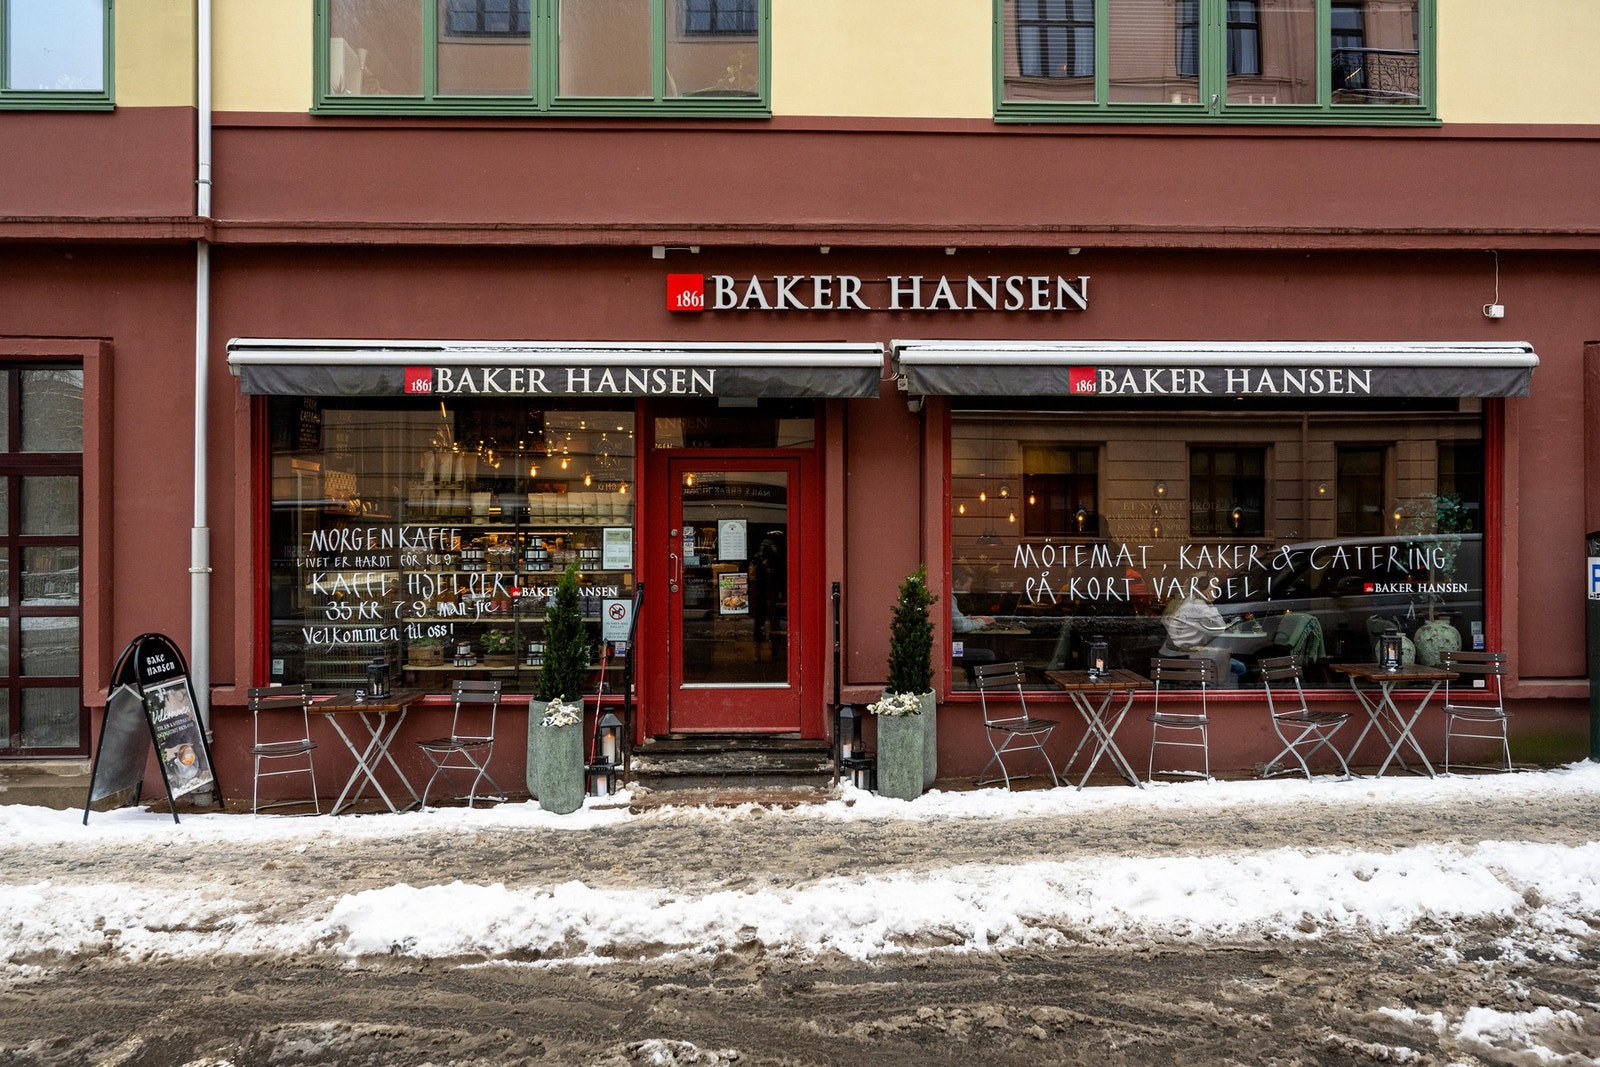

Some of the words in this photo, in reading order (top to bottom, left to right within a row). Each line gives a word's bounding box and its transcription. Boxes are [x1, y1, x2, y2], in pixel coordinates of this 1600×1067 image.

[676, 290, 704, 307] 1861
[712, 274, 871, 310] BAKER
[887, 275, 1090, 310] HANSEN
[411, 379, 432, 392] 1861
[435, 367, 551, 394] BAKER
[565, 367, 717, 396] HANSEN
[1075, 380, 1096, 393] 1861
[1098, 368, 1213, 395] BAKER
[1224, 368, 1373, 395] HANSEN
[334, 556, 352, 568] ER
[355, 555, 393, 568] HARDT
[443, 553, 452, 566] 9
[1180, 544, 1268, 571] KAKER
[1272, 544, 1305, 573] &
[312, 572, 393, 598] KAFFE
[577, 586, 619, 598] ANSEN
[1026, 571, 1058, 604] PÅ
[1070, 576, 1136, 602] KORT
[1152, 576, 1272, 602] VARSEL!
[1374, 582, 1414, 593] BAKER
[1418, 582, 1468, 593] HANSEN
[325, 600, 353, 620] 35
[358, 600, 384, 620] KR
[302, 626, 401, 655] Velkommen
[403, 623, 424, 640] til
[427, 622, 455, 644] oss!
